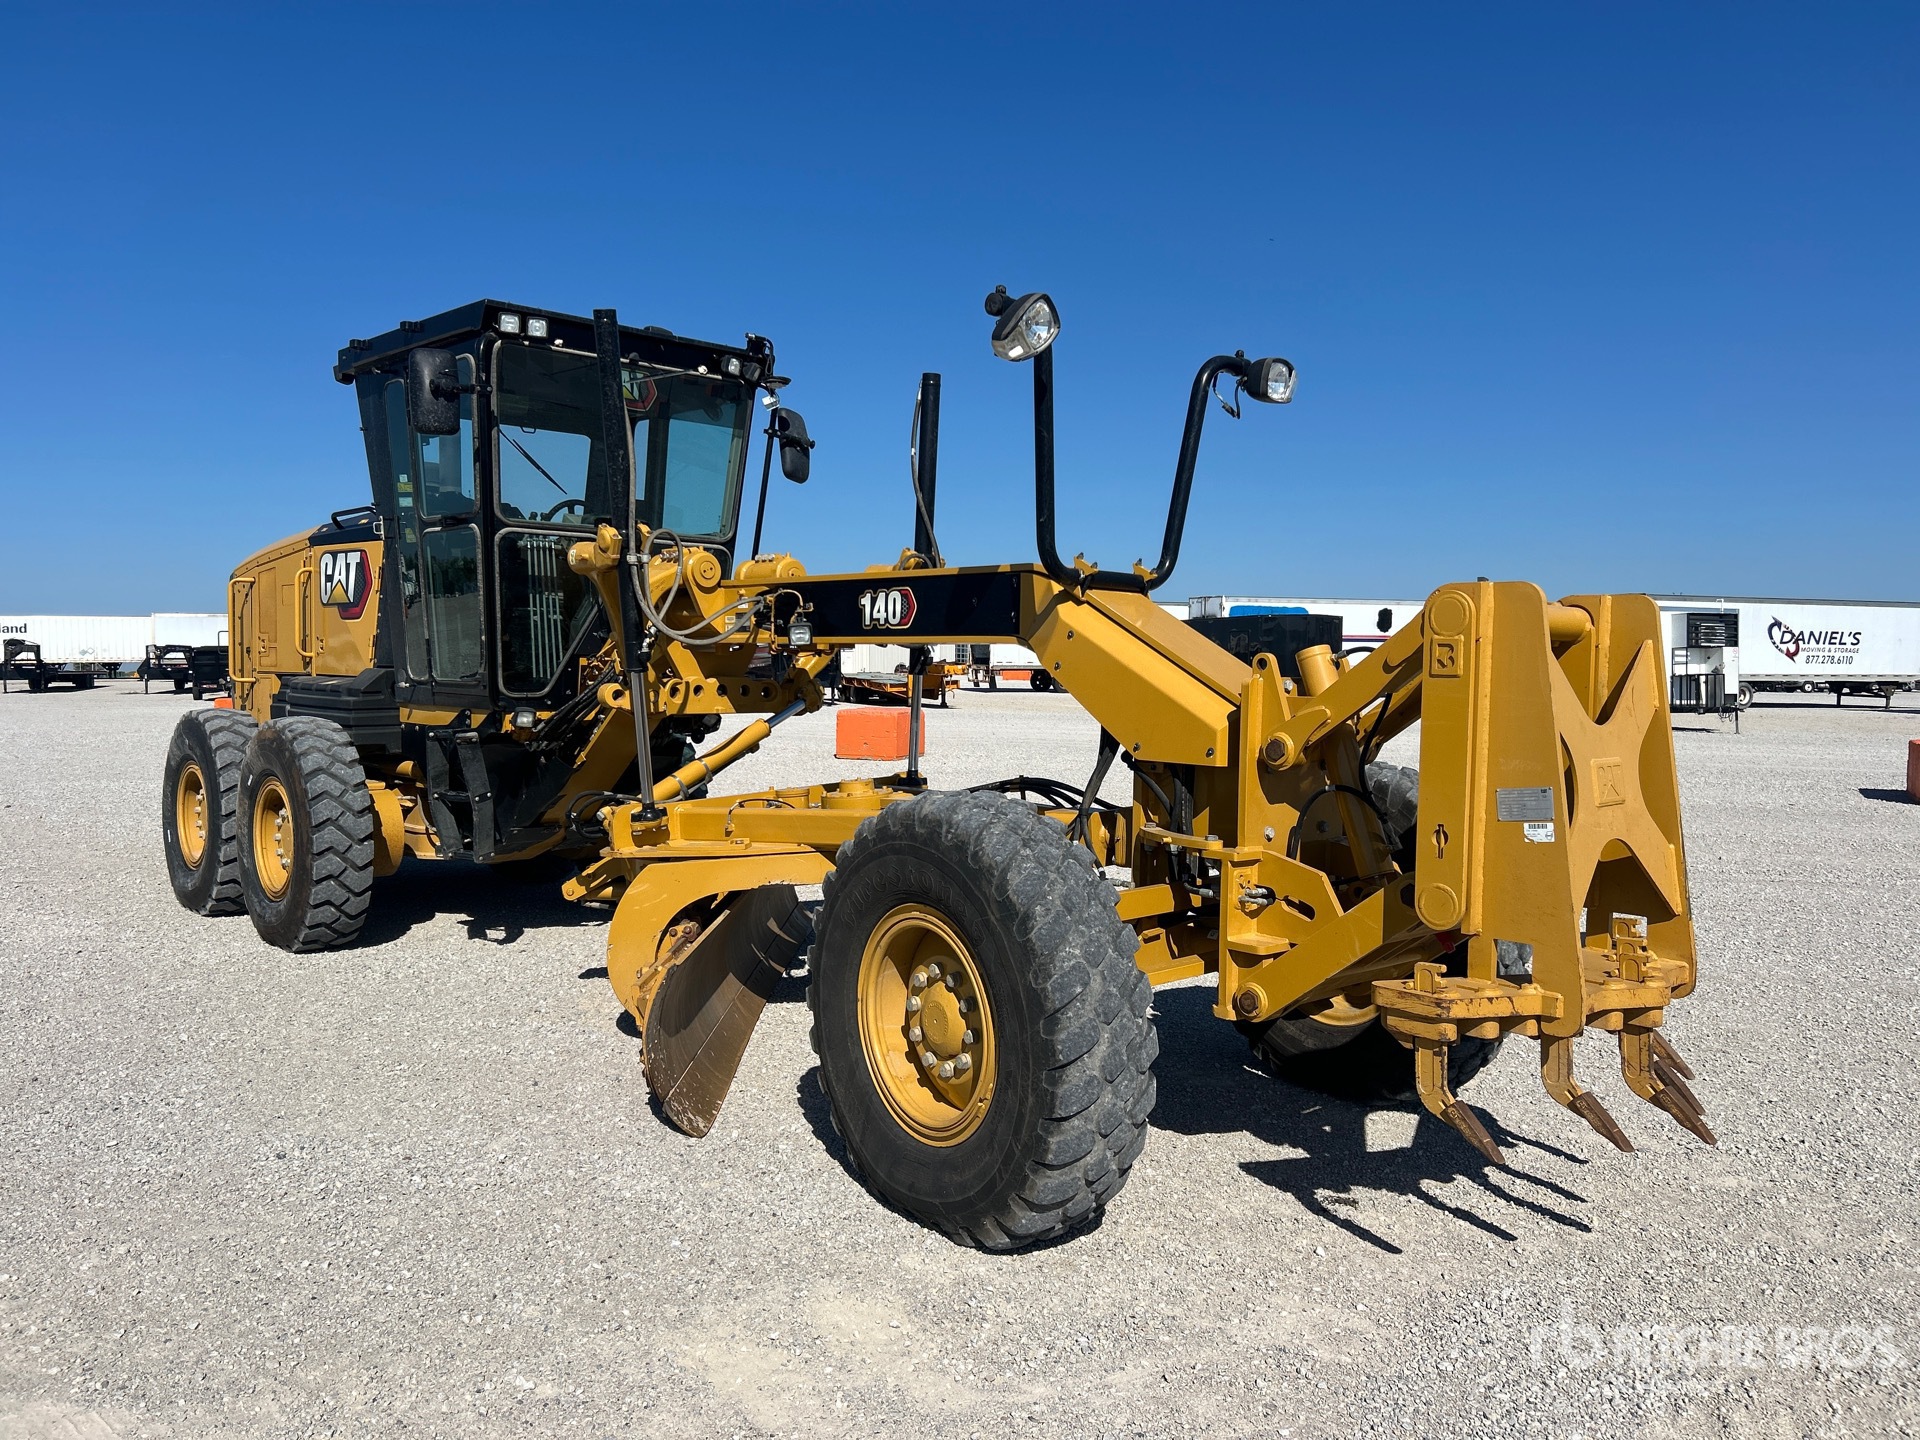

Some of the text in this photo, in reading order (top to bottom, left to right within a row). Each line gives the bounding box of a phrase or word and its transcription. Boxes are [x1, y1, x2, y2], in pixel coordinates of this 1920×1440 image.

[320, 551, 361, 604] CAT
[860, 590, 902, 625] 140
[0, 623, 27, 634] and
[1779, 630, 1862, 646] DANIEL'S
[1805, 655, 1854, 665] 877.278.6110
